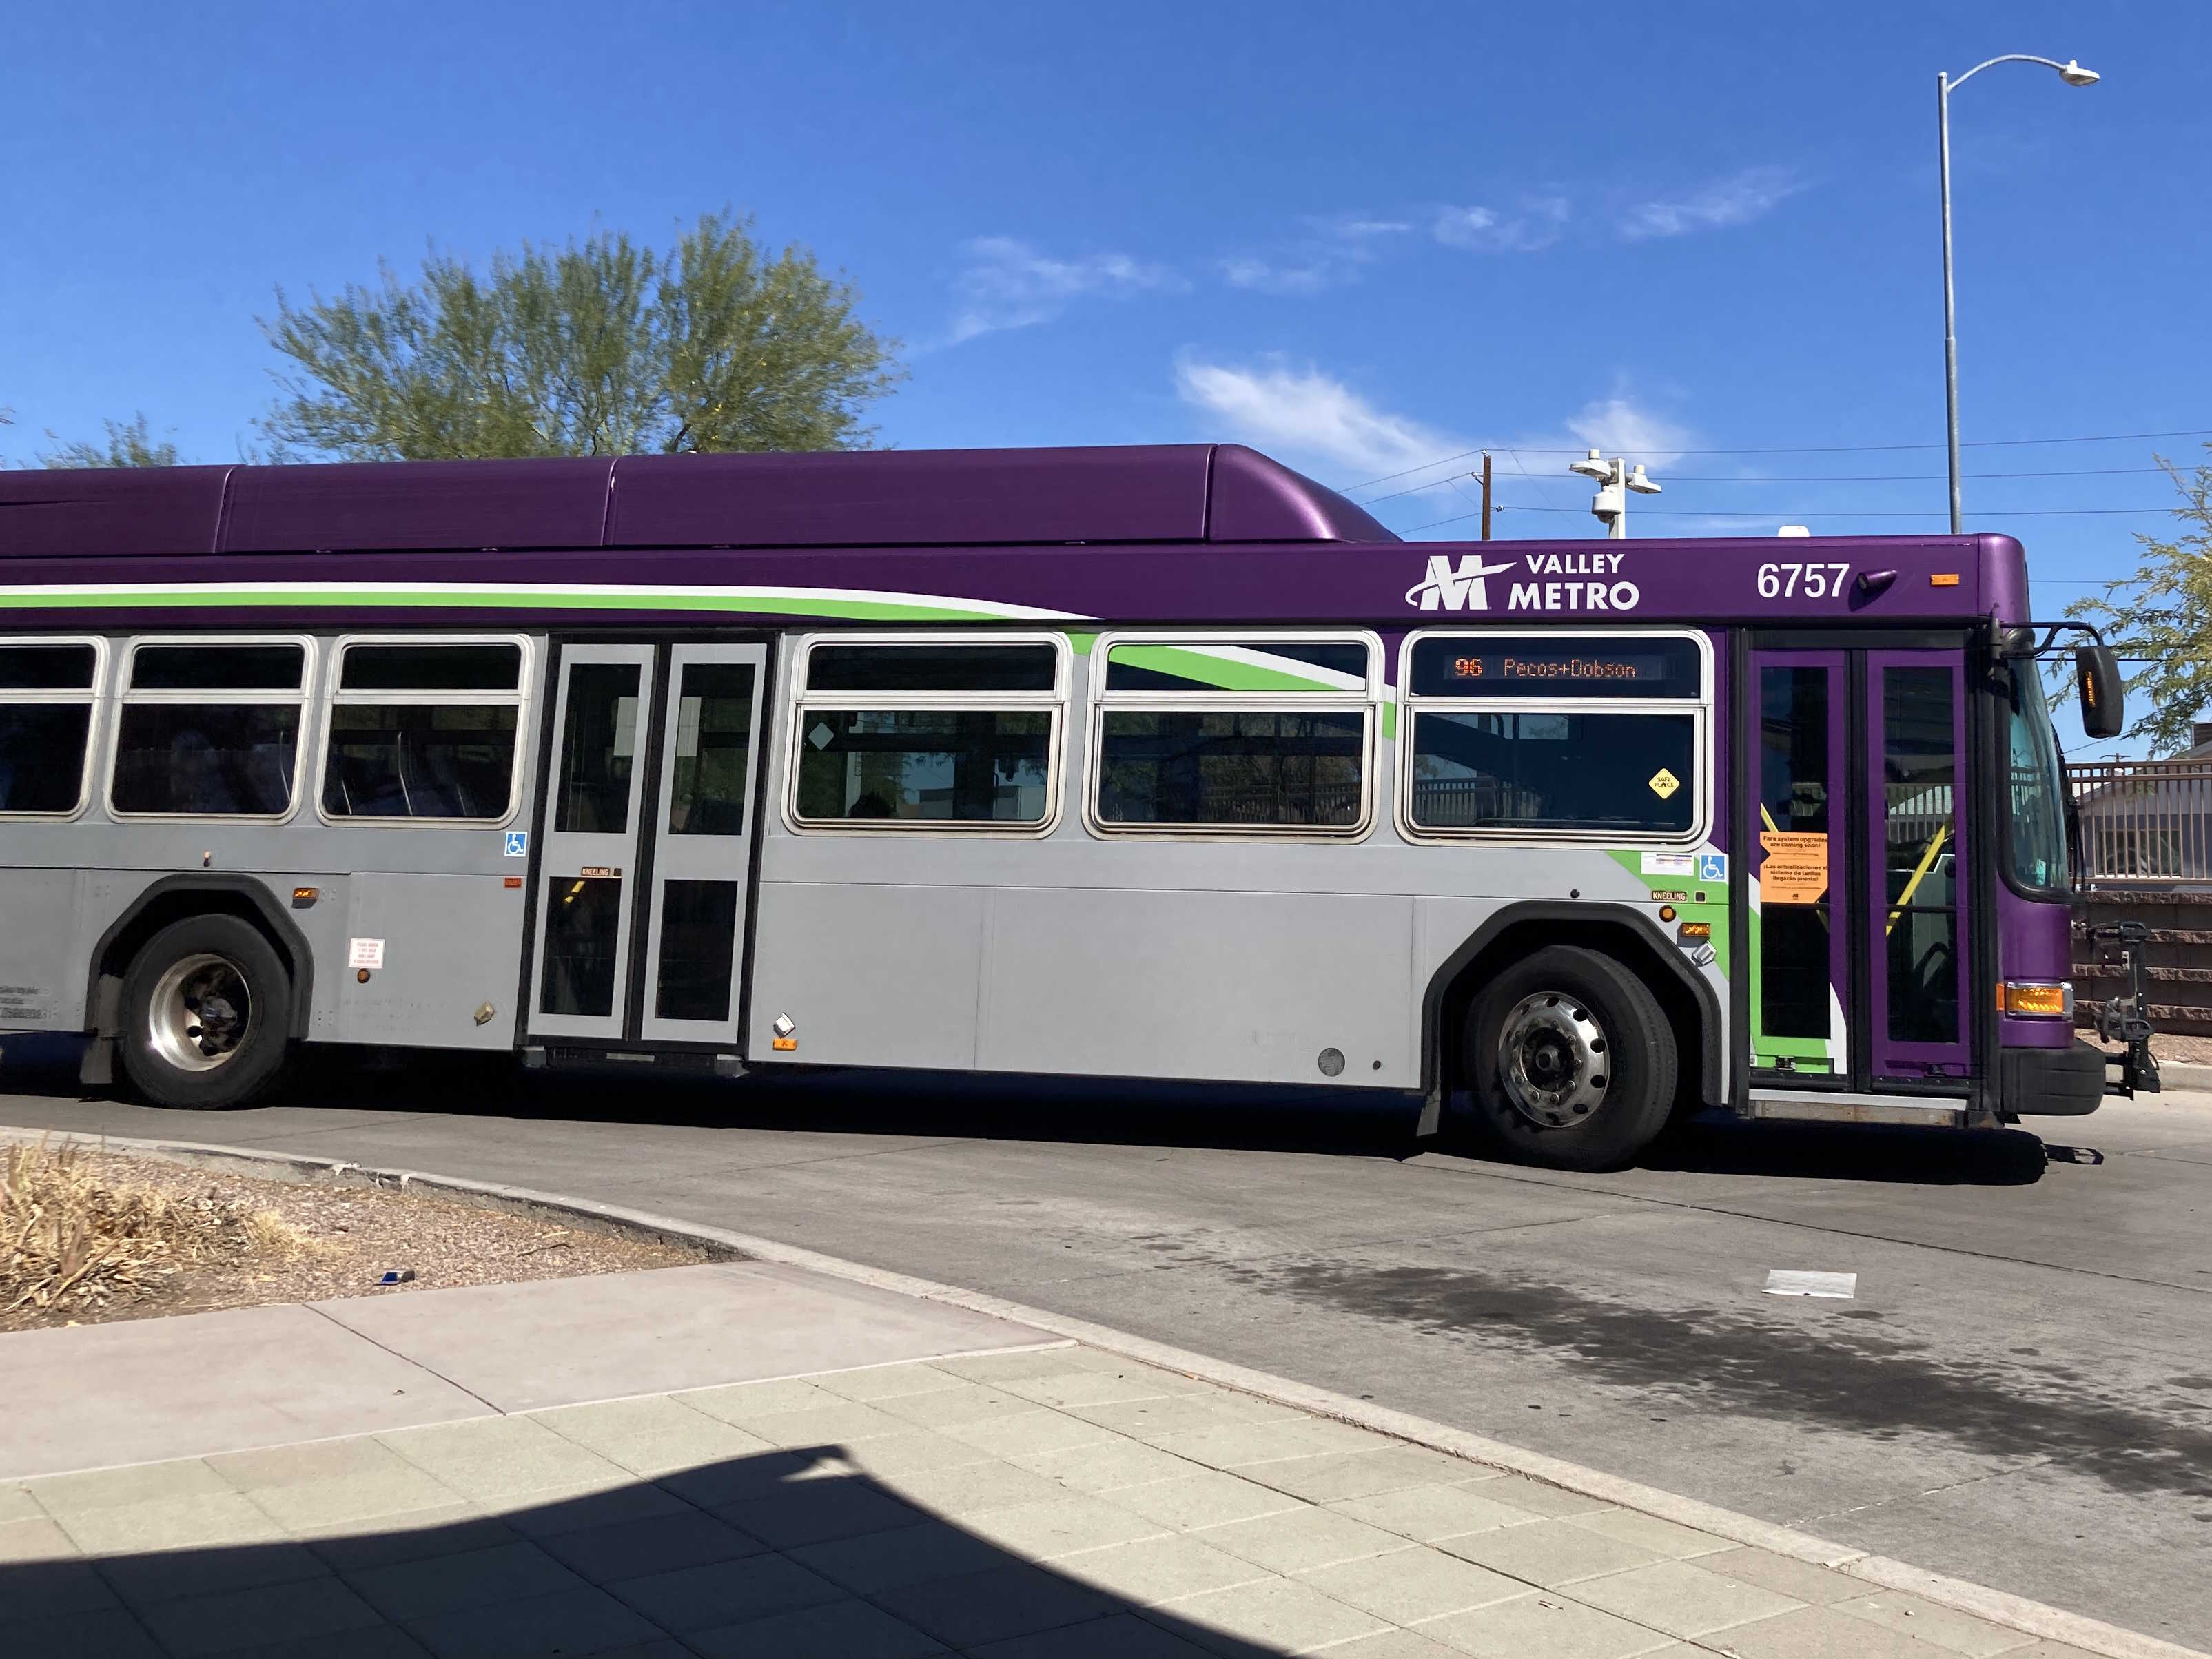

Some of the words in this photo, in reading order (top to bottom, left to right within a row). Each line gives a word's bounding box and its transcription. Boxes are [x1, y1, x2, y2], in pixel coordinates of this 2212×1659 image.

[1525, 553, 1625, 574] VALLEY
[1757, 563, 1850, 598] 6757
[1508, 581, 1640, 610] METRO
[1454, 657, 1483, 677] 96
[1504, 658, 1637, 678] Pecos+Dobson
[582, 868, 610, 876] KNEELING
[1652, 892, 1686, 901] KNEELING
